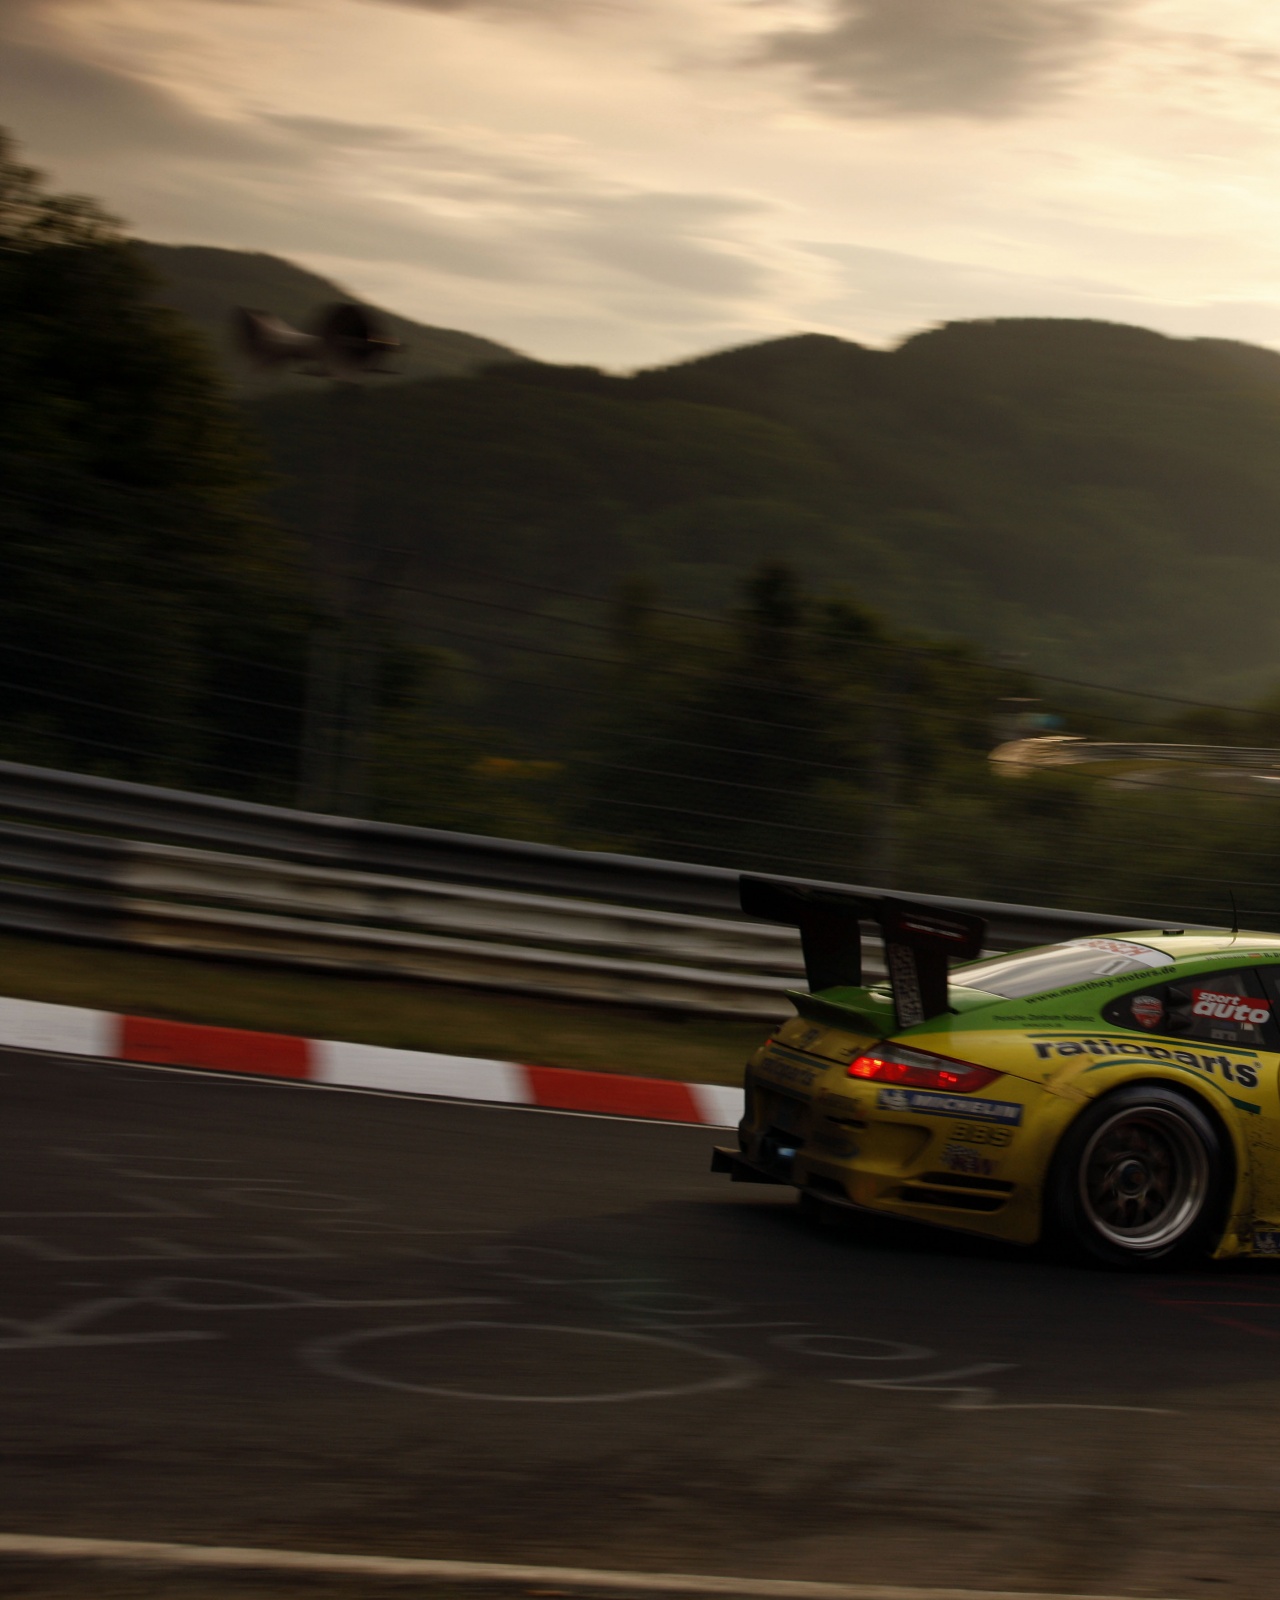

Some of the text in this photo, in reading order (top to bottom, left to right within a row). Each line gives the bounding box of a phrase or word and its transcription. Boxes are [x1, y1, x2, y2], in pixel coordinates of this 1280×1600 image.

[1024, 965, 1177, 1004] www.manthey-motors.de
[1198, 992, 1241, 1005] sport
[1192, 1000, 1270, 1024] auto
[1033, 1038, 1259, 1089] ratioparts
